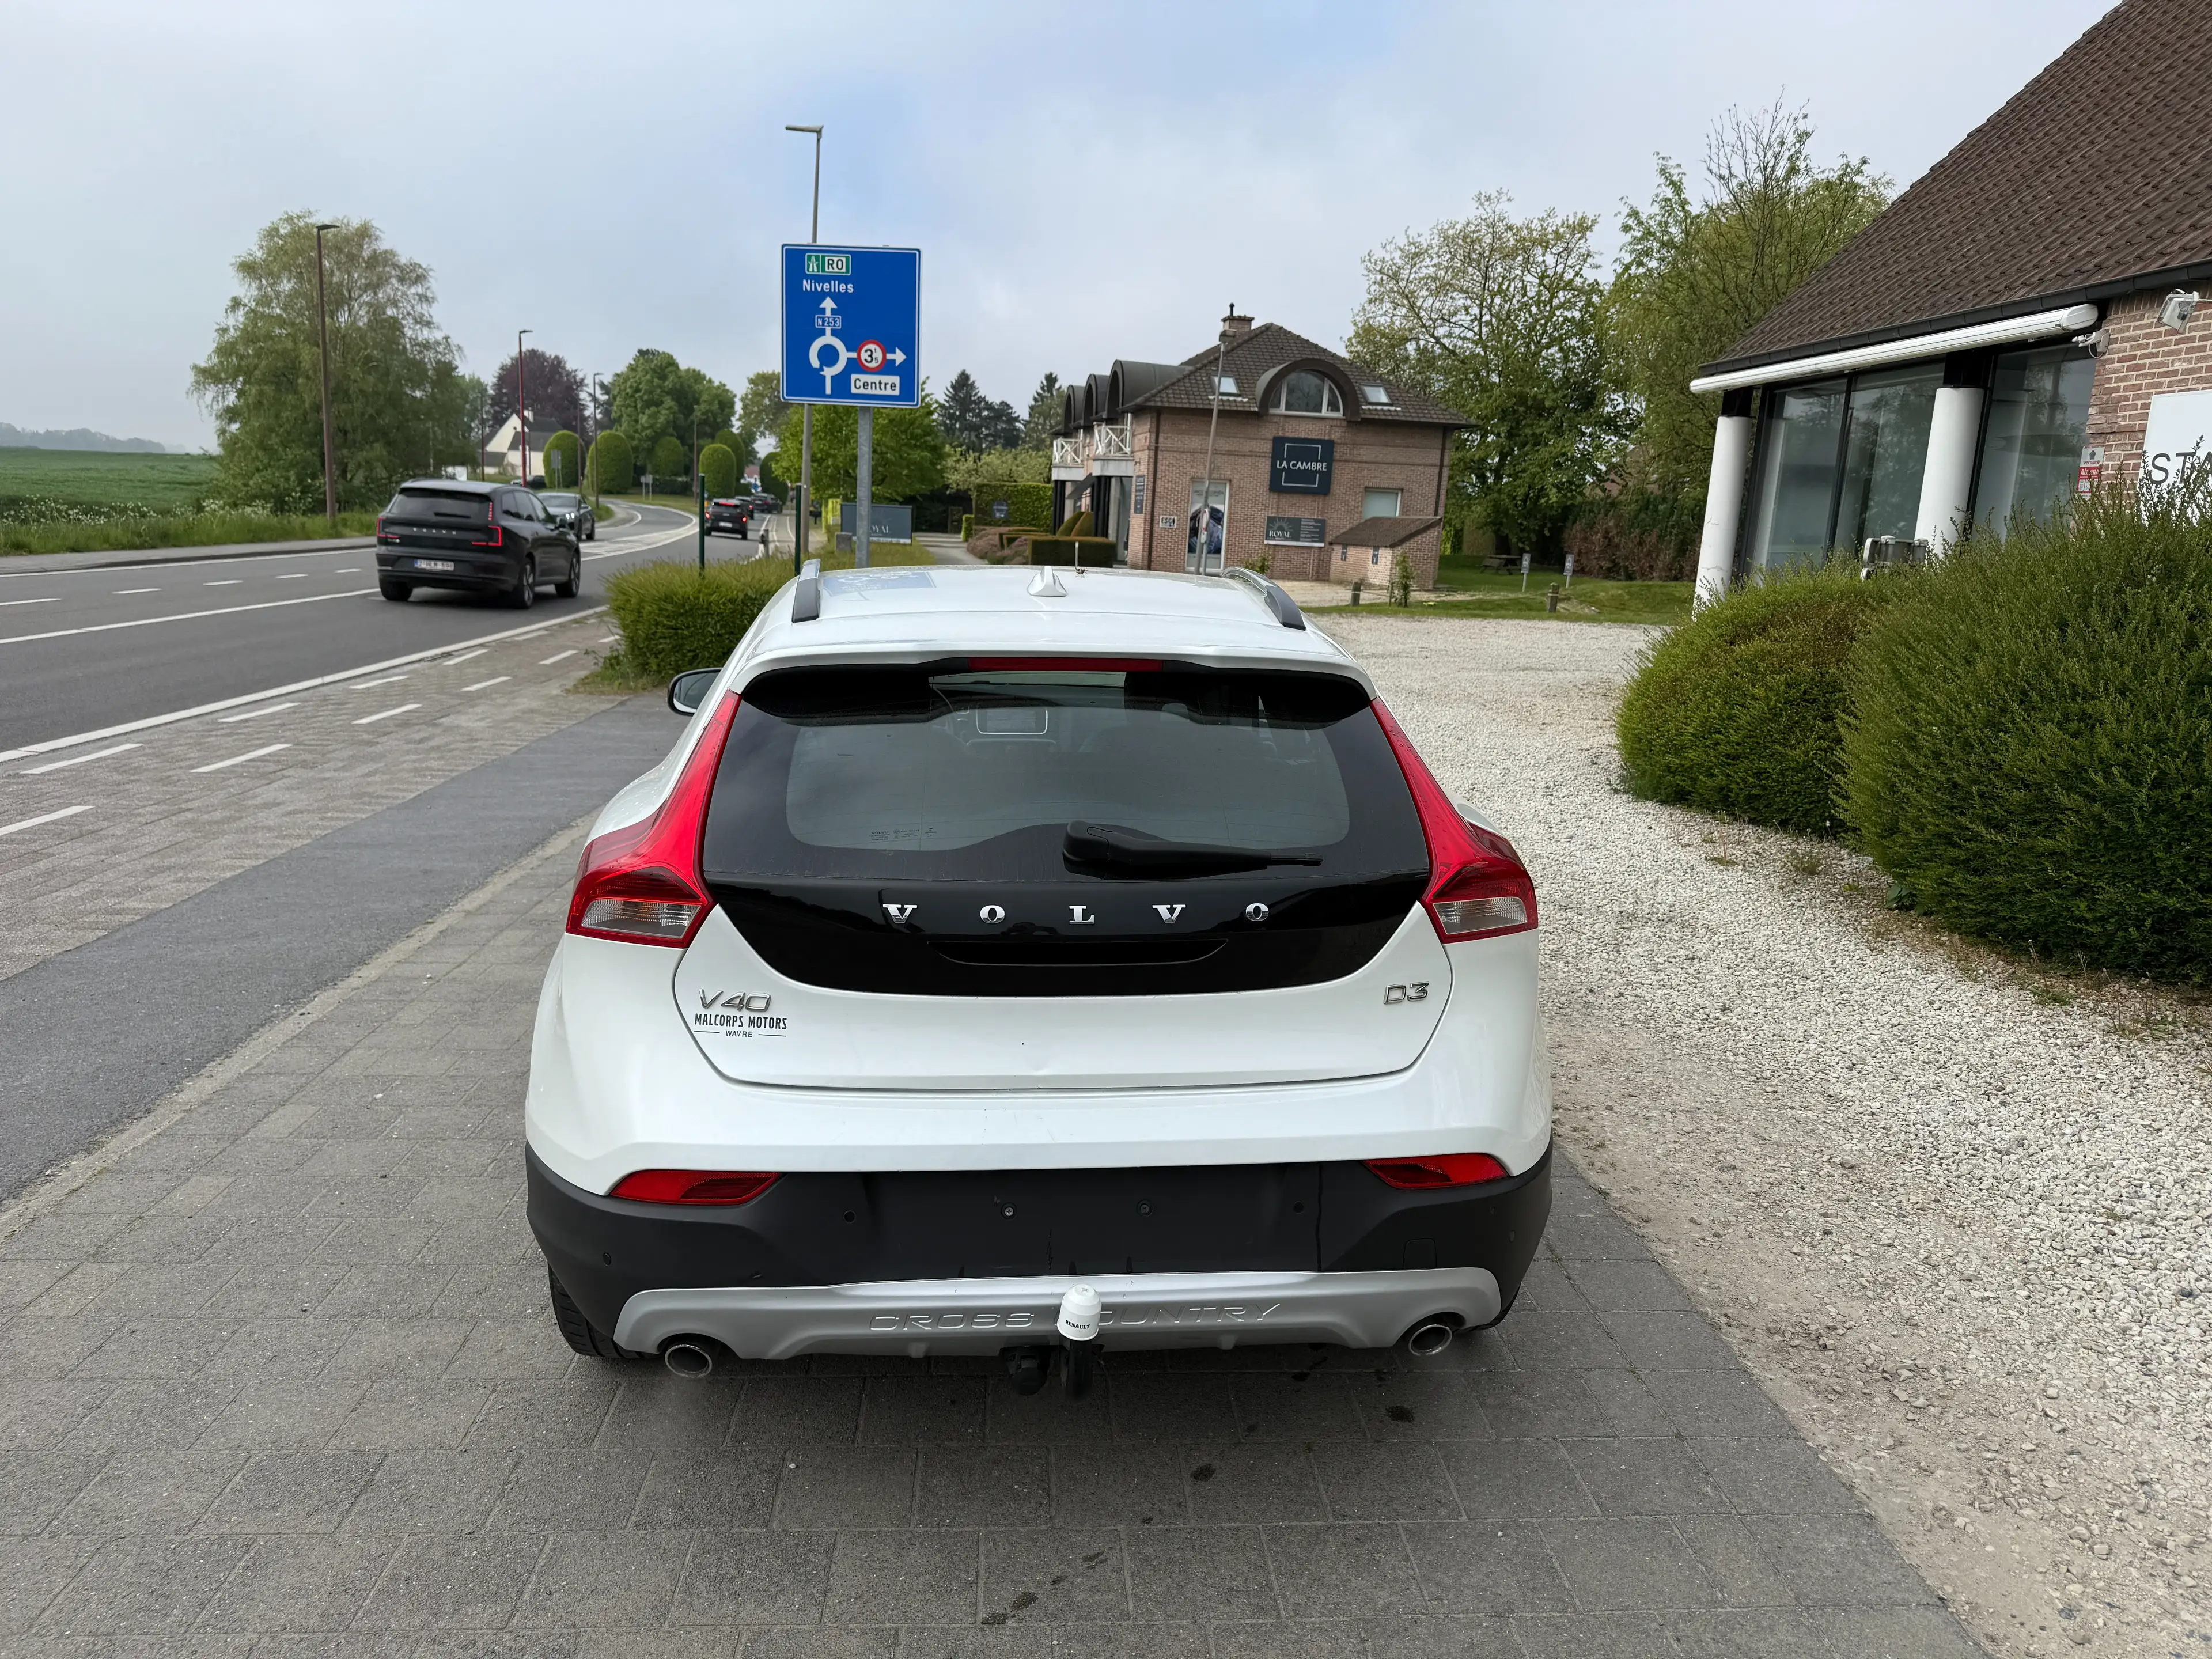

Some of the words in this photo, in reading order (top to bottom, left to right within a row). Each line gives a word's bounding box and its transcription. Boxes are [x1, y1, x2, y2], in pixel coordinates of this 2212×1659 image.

[802, 279, 854, 293] Nivelles
[854, 378, 897, 391] Centre
[1277, 460, 1287, 469] LA
[1290, 461, 1327, 471] CAMBRE
[1269, 530, 1291, 538] ROYAL
[882, 903, 1270, 925] VOLVO
[698, 988, 772, 1012] V40
[1383, 980, 1429, 1005] D3
[694, 1013, 744, 1027] MALCORPS
[748, 1016, 787, 1029] MOTORS
[869, 1312, 1034, 1331] CROSS
[1065, 1319, 1090, 1330] RENAULT
